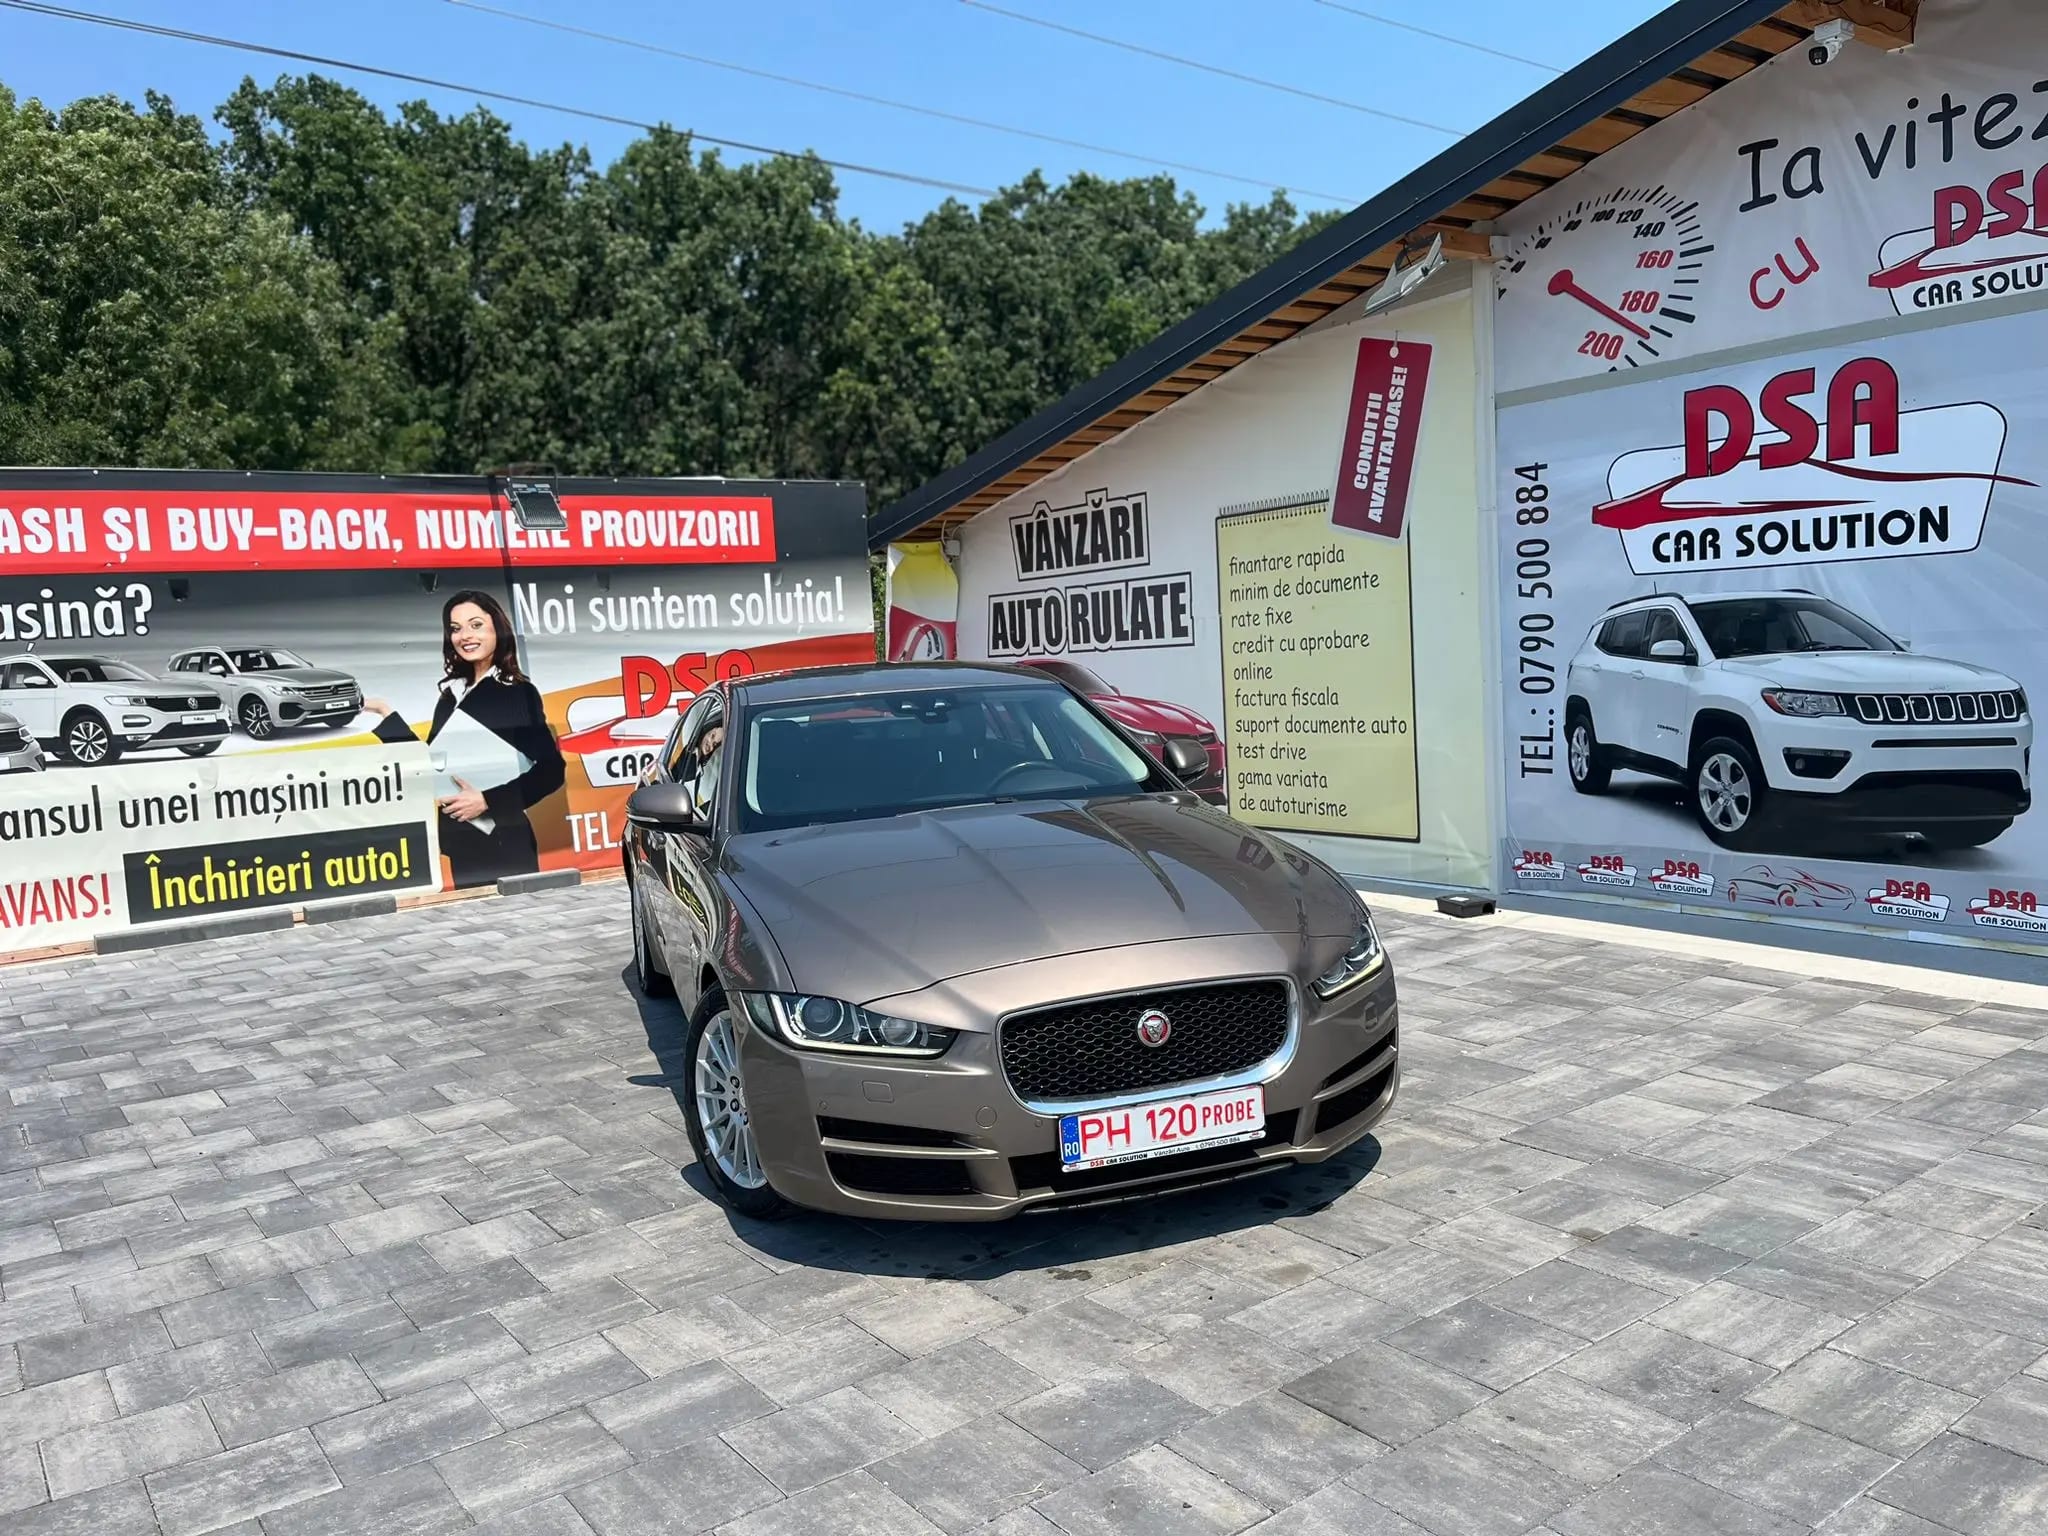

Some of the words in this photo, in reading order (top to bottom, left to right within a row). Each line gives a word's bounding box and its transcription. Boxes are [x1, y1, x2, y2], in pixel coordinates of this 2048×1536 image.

[1738, 138, 1824, 212] Ia
[1591, 208, 1615, 223] 100
[1616, 208, 1643, 223] 120
[1633, 222, 1665, 238] 140
[1635, 250, 1673, 268] 160
[1750, 237, 1820, 310] cu
[1912, 280, 1962, 308] CAR
[1972, 262, 2048, 298] SOLU
[1619, 290, 1660, 313] 180
[1577, 331, 1624, 360] 200
[1684, 357, 1899, 479] DSA
[1354, 393, 1383, 490] CONDITII
[1368, 366, 1408, 523] AVANTAJOASE!
[1514, 462, 1549, 525] 884
[102, 507, 152, 564] ȘI
[167, 507, 403, 553] BUY-BACK,
[580, 510, 760, 548] PROVIZORII
[1015, 496, 1144, 574] VÂNZĂRI
[1652, 528, 1720, 563] CAR
[1736, 505, 1949, 558] SOLUTION
[1229, 555, 1292, 576] finantare
[1297, 544, 1345, 571] rapida
[1516, 538, 1553, 599] 500
[1230, 583, 1268, 602] minim
[1273, 579, 1291, 597] de
[1296, 571, 1380, 595] documente
[512, 583, 575, 635] Noi
[589, 586, 719, 632] suntem
[730, 573, 846, 633] soluția!
[992, 596, 1064, 650] AUTO
[1070, 582, 1189, 645] RULATE
[1231, 611, 1260, 628] rate
[1265, 607, 1293, 626] fixe
[1232, 635, 1275, 654] credit
[1279, 637, 1296, 652] cu
[1300, 630, 1370, 656] aprobare
[1519, 613, 1555, 695] 0790
[1234, 661, 1273, 681] online
[1235, 689, 1287, 707] factura
[1292, 687, 1339, 707] fiscala
[1235, 716, 1280, 738] suport
[1285, 715, 1367, 735] documente
[1371, 716, 1407, 735] auto
[1237, 743, 1265, 759] test
[1270, 741, 1307, 760] drive
[1520, 708, 1554, 778] TEL.:
[1238, 771, 1272, 789] gama
[1277, 770, 1328, 788] variata
[0, 785, 103, 841] ansul
[119, 782, 200, 829] unei
[214, 770, 329, 824] mașini
[343, 762, 404, 807] noi!
[1239, 793, 1255, 811] de
[1260, 795, 1348, 817] autoturisme
[145, 853, 313, 910] Închirieri
[324, 838, 411, 887] auto!
[1590, 855, 1624, 871] DSA
[1664, 860, 1699, 879] DSA
[1672, 884, 1708, 894] SOLUTION
[1886, 879, 1930, 902] DSA
[1989, 888, 2036, 912] DSA
[1877, 905, 1893, 913] CAR
[1895, 907, 1939, 919] SOLUTION
[1981, 916, 1998, 925] CAR
[2000, 918, 2047, 931] SOLUTION
[1080, 1112, 1131, 1154] PH
[1146, 1103, 1197, 1141] 120
[1202, 1098, 1255, 1128] PROBE
[1064, 1141, 1079, 1157] RO
[1118, 1153, 1148, 1163] SOLUTION
